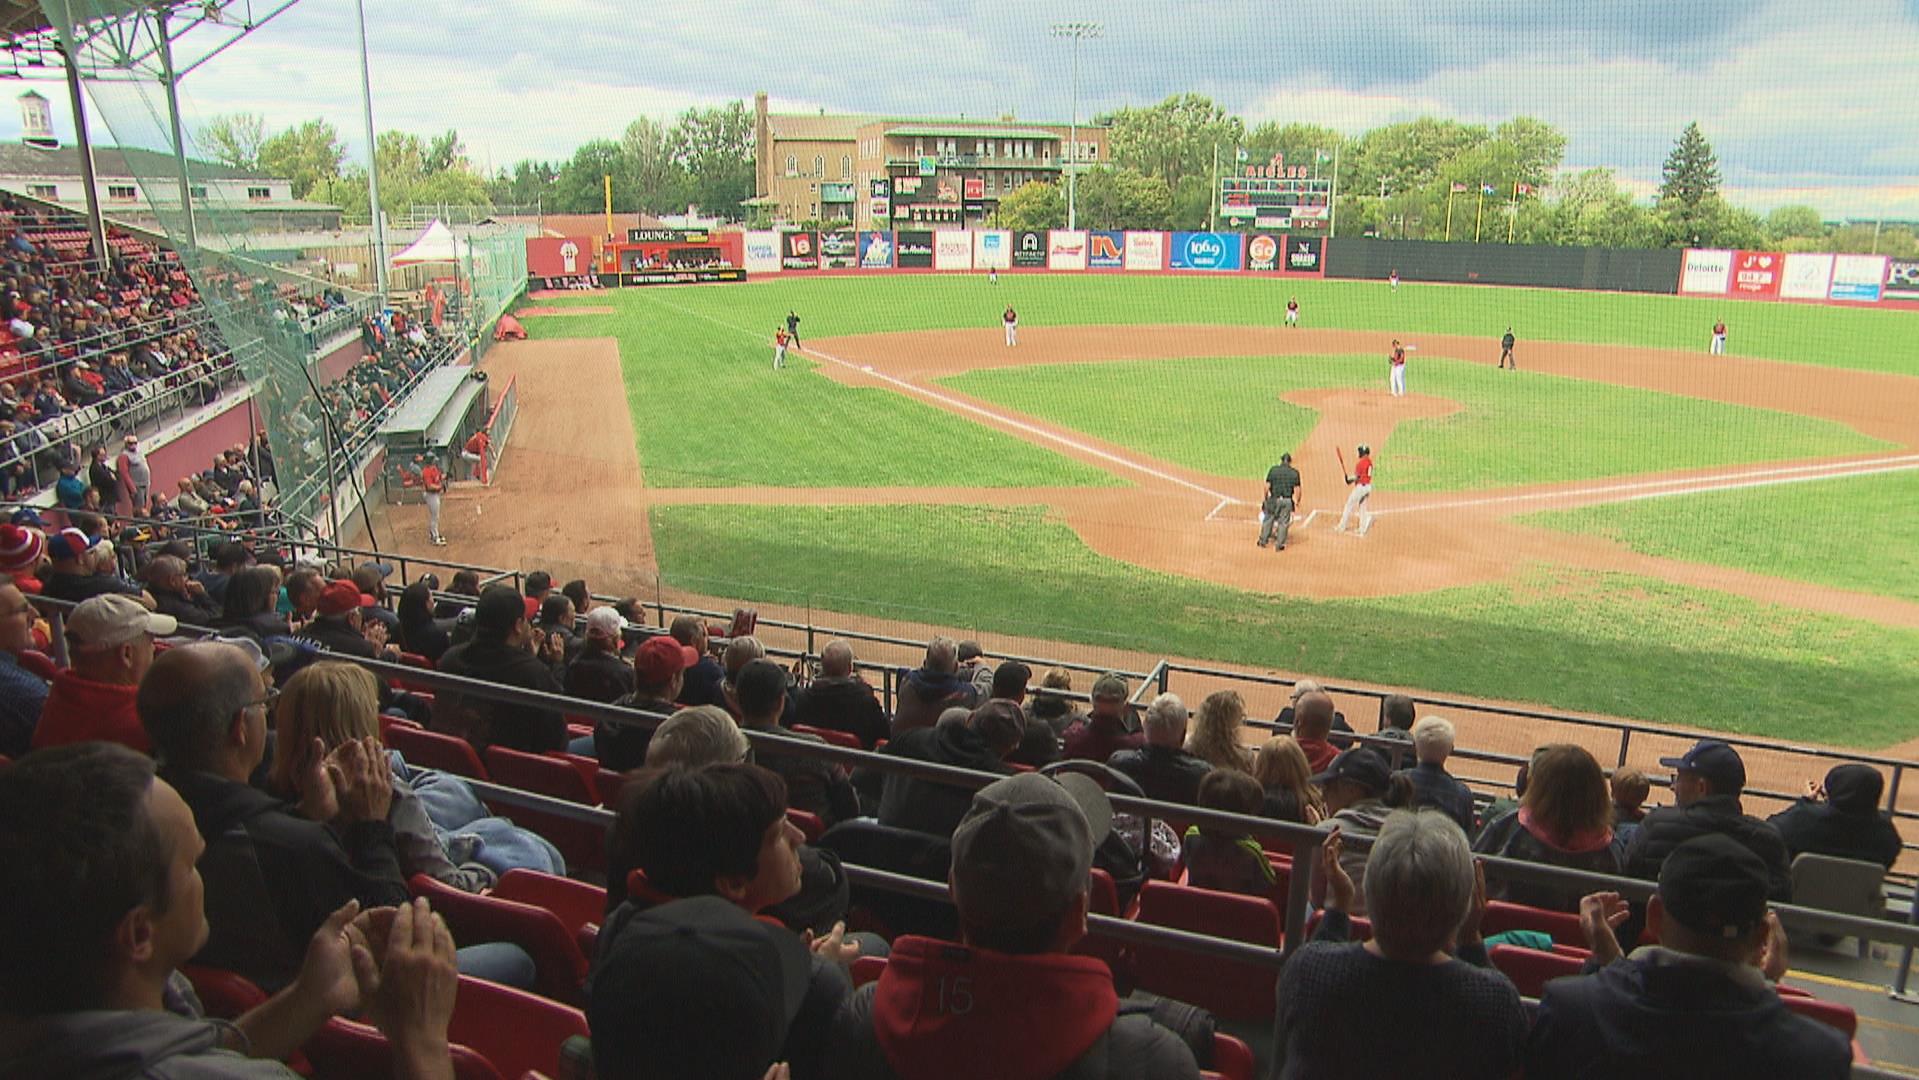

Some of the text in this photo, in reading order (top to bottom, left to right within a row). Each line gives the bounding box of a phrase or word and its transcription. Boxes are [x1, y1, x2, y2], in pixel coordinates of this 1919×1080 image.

[1245, 165, 1306, 178] AIGLES
[634, 230, 676, 241] LOUNGE
[1191, 240, 1220, 256] 106.9
[1687, 263, 1724, 273] Deloitte
[937, 976, 974, 1014] 15
